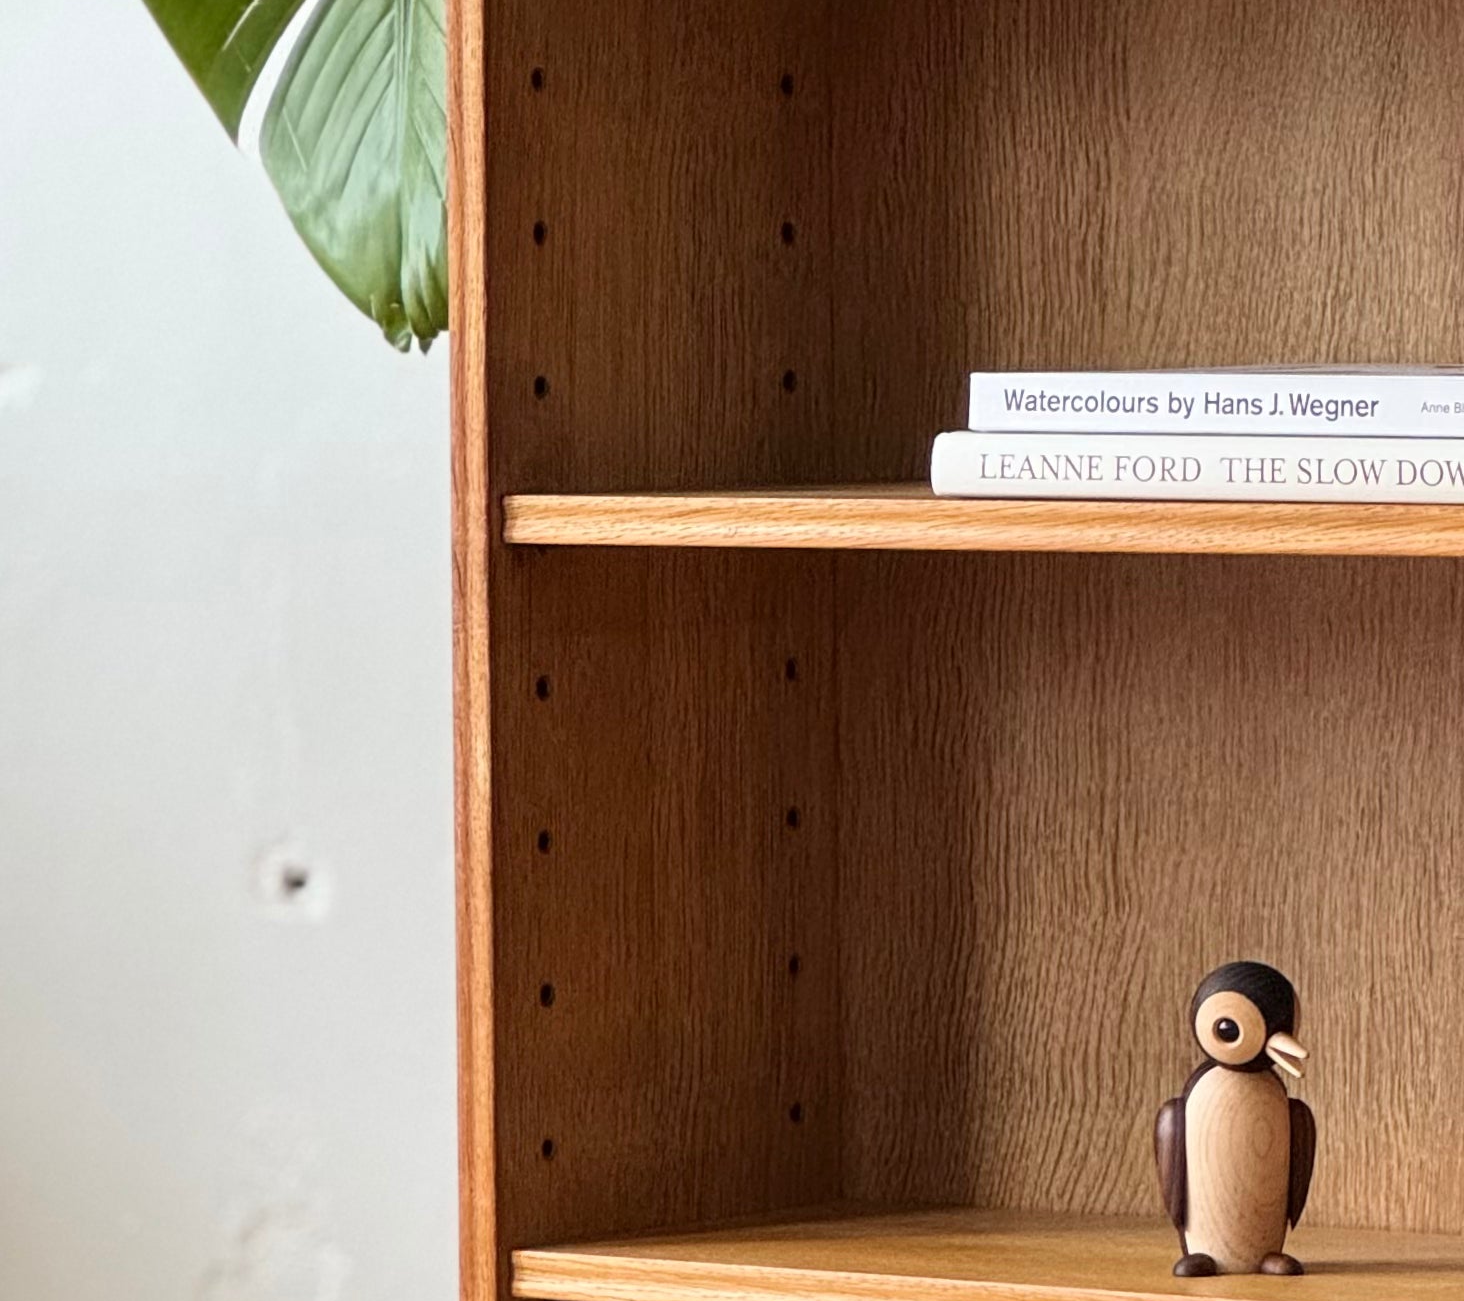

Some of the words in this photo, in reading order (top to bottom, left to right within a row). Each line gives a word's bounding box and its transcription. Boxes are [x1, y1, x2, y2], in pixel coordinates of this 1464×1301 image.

[1003, 388, 1159, 414] Watercolours
[1167, 391, 1195, 420] by
[1204, 391, 1263, 416] Hans
[1268, 392, 1284, 416] J.
[1289, 392, 1380, 422] Wegner
[1420, 401, 1451, 414] Anne
[979, 453, 1104, 481] LEANNE
[1114, 455, 1202, 483] FORD
[1219, 457, 1287, 484] THE
[1297, 457, 1388, 486] SLOW
